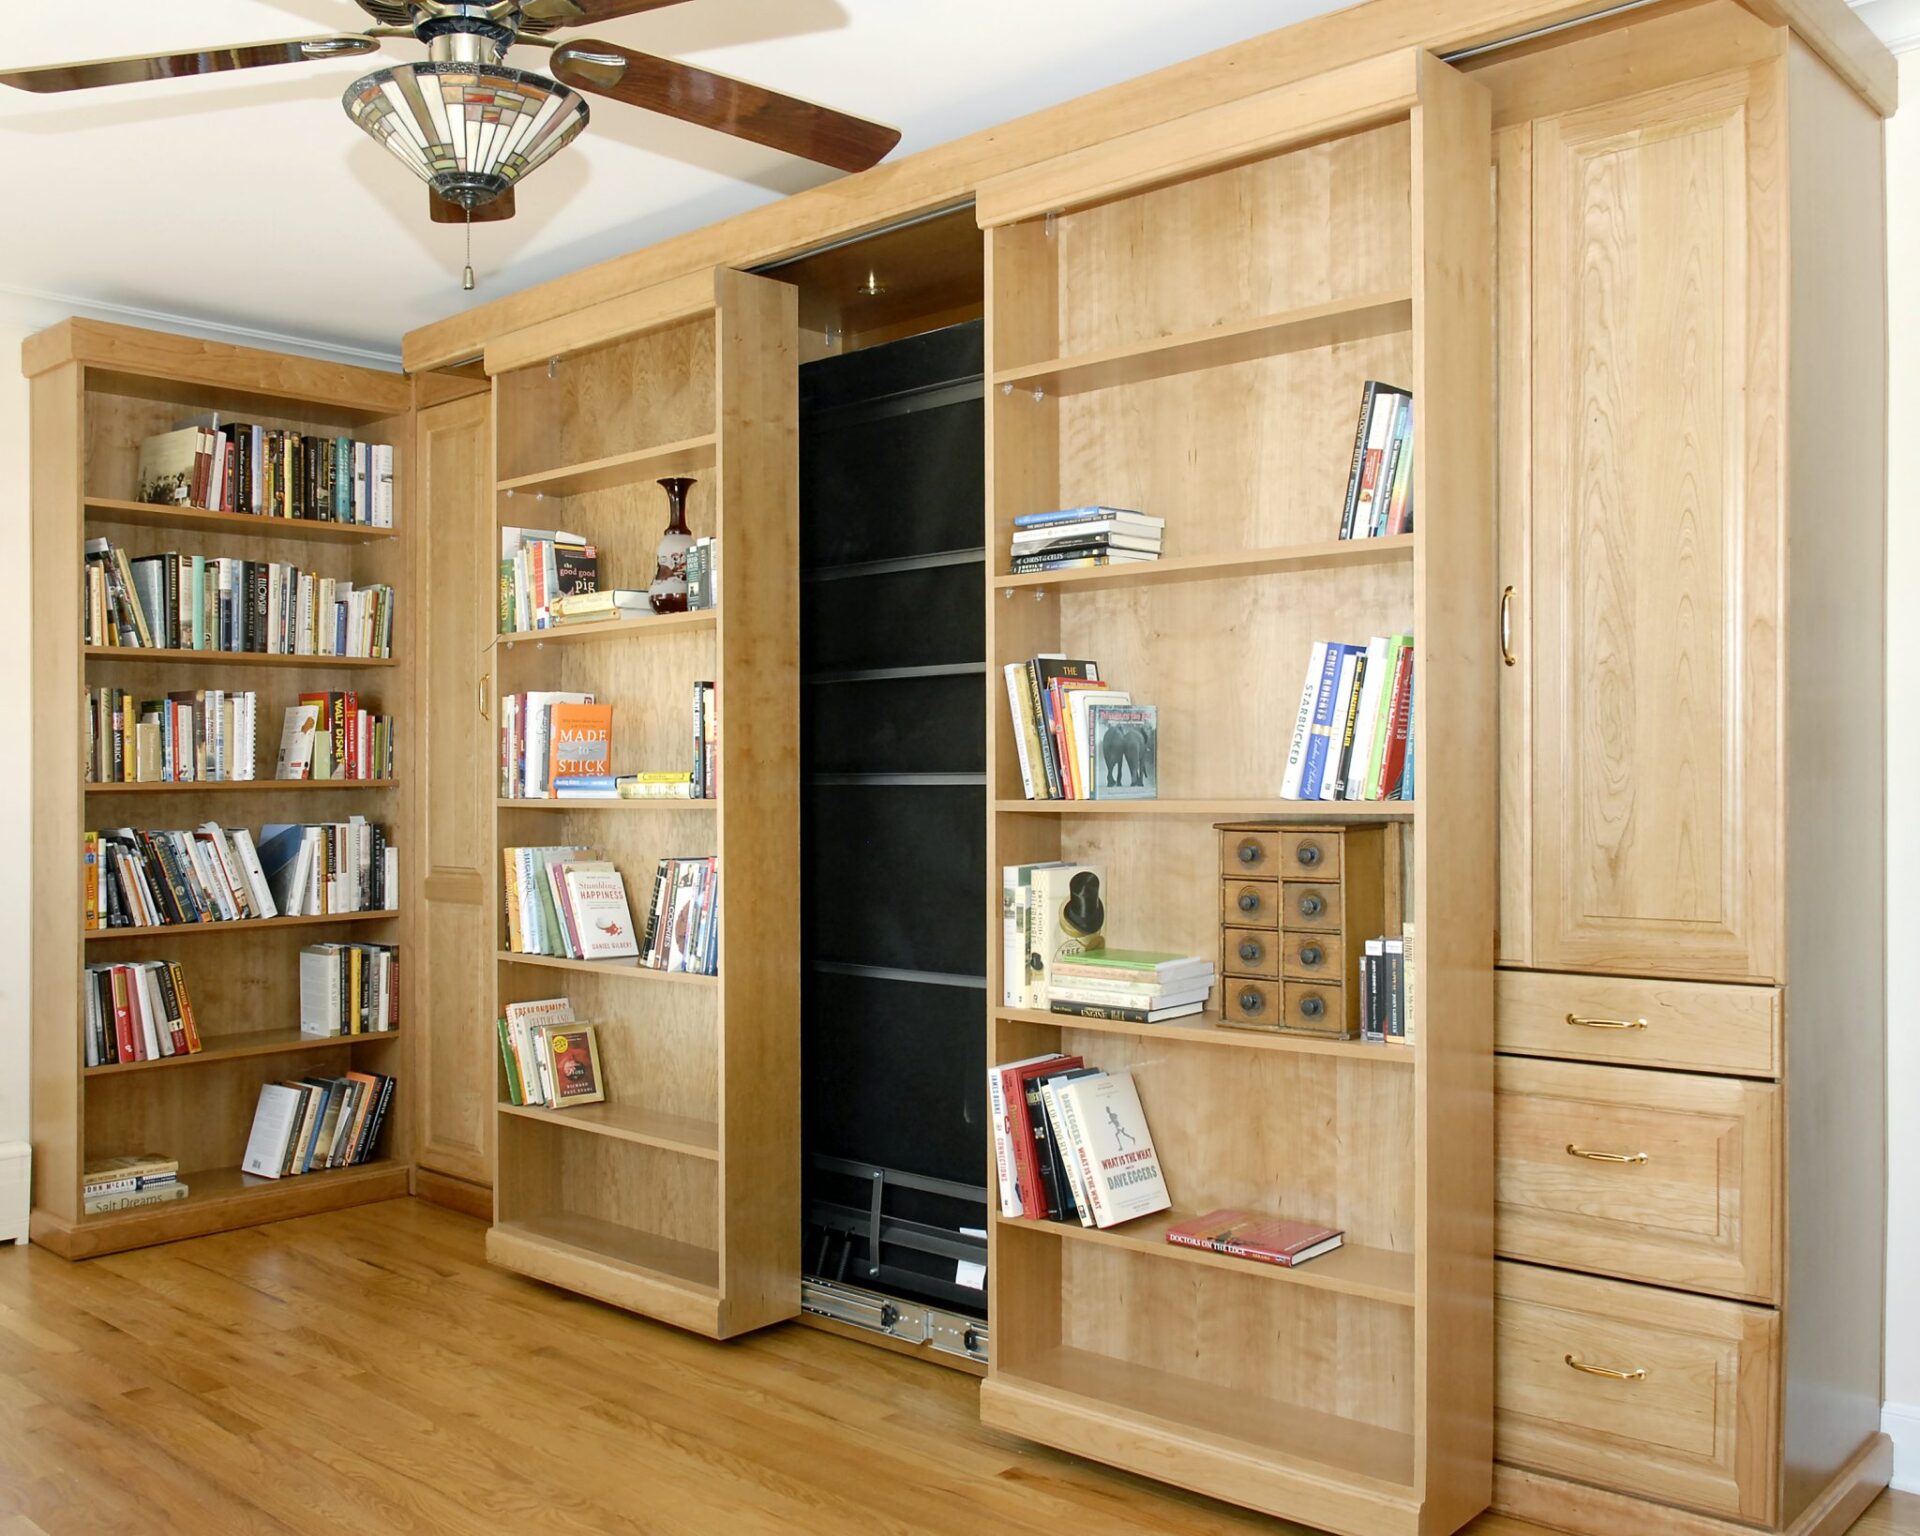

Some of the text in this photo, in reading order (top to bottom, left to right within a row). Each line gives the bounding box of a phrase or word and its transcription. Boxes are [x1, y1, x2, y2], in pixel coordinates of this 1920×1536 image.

[1358, 403, 1368, 438] BIOLOGY
[1352, 448, 1361, 473] BELIEF
[559, 567, 596, 578] good good
[575, 579, 596, 594] pig
[1063, 666, 1078, 676] THE
[1316, 649, 1338, 721] COKIE ROBERTS
[1030, 680, 1044, 718] ASSOCIATE
[334, 698, 344, 764] WALT DISNEY
[559, 729, 609, 743] MADE
[1289, 684, 1314, 765] STARBUCKED
[577, 745, 590, 755] to
[558, 759, 605, 773] STICK
[578, 880, 617, 891] Stumbling
[580, 888, 624, 900] HAPPINESS
[663, 905, 675, 949] COOKIES
[591, 940, 633, 951] DANIEL GILBERT
[1061, 947, 1081, 957] FREE
[992, 1075, 1008, 1182] JAMES BURKE CONNECTIONS
[1044, 1091, 1052, 1108] OUT
[1053, 1120, 1069, 1159] POVERTY
[1061, 1093, 1072, 1114] DAVE
[1068, 1114, 1083, 1146] EGGERS
[1078, 1148, 1088, 1168] WHAT
[1087, 1176, 1095, 1190] THE
[1091, 1190, 1102, 1210] WHAT
[1101, 1157, 1120, 1171] WHAT
[1124, 1153, 1137, 1163] THE
[1135, 1148, 1153, 1162] WHAT
[1106, 1165, 1158, 1190] DAVE EGGERS
[96, 1194, 163, 1215] Salt Dreams
[1169, 1233, 1247, 1256] DOCTORS ON THE EDGE
